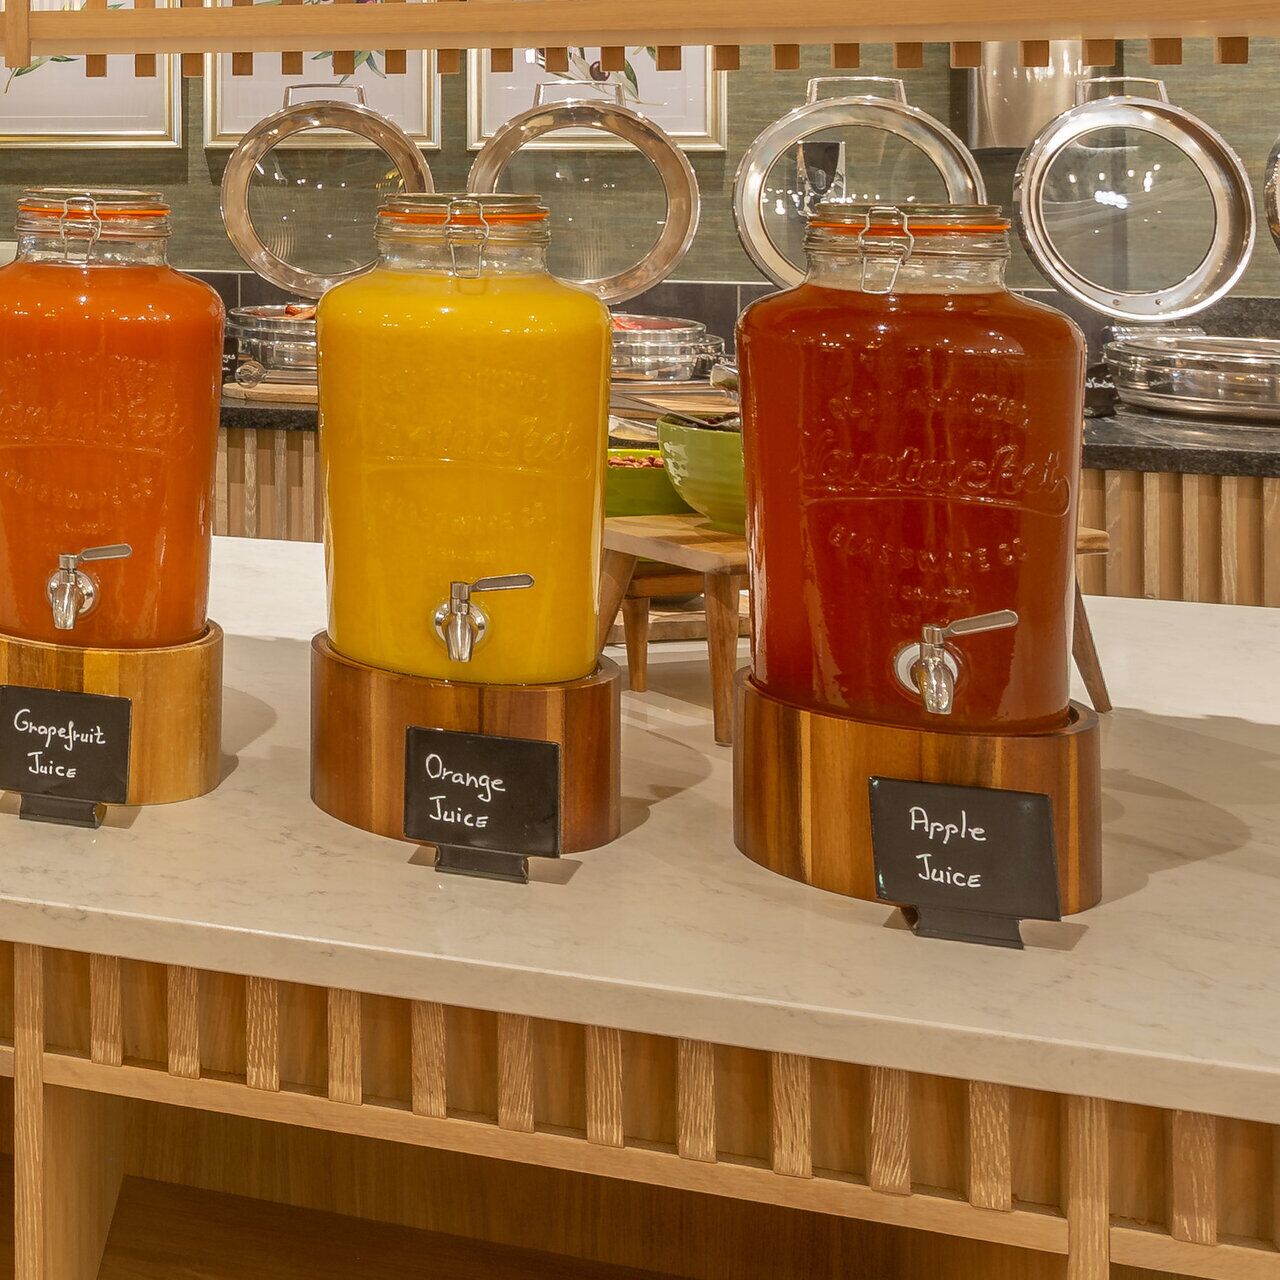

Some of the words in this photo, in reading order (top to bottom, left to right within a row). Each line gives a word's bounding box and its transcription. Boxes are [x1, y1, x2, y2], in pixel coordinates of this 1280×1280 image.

[14, 708, 106, 751] Grapefruit
[425, 753, 506, 802] Orange
[909, 806, 987, 844] Apple
